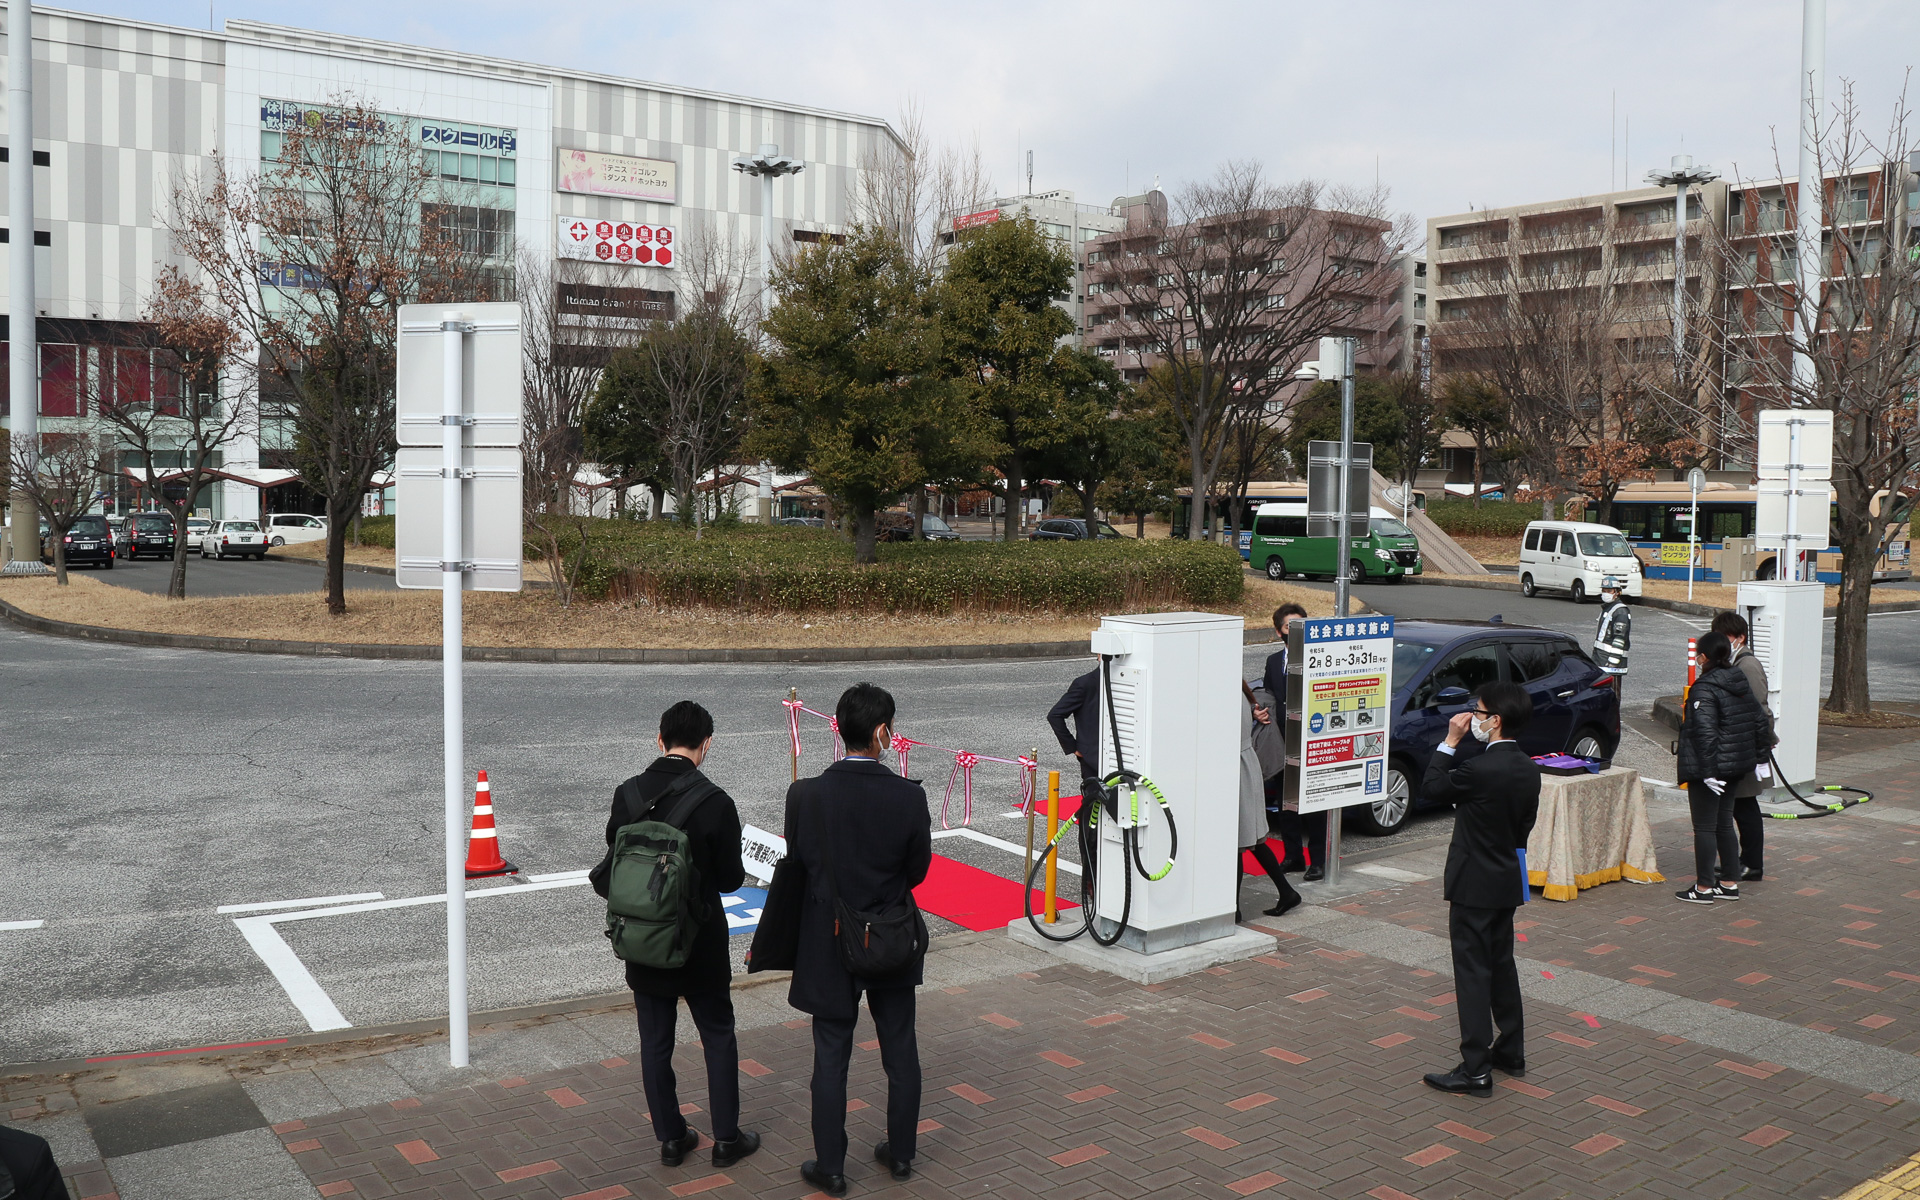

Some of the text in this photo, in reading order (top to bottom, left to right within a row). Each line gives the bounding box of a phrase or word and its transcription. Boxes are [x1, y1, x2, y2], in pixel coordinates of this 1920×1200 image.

[423, 126, 496, 150] スクール
[502, 130, 512, 156] 5F
[608, 164, 627, 173] テニス
[607, 174, 668, 187] ダンス ホットヨガ
[566, 296, 600, 306] Itoman
[1310, 622, 1389, 638] 社会実験実施中
[741, 837, 786, 867] V充電器の公
